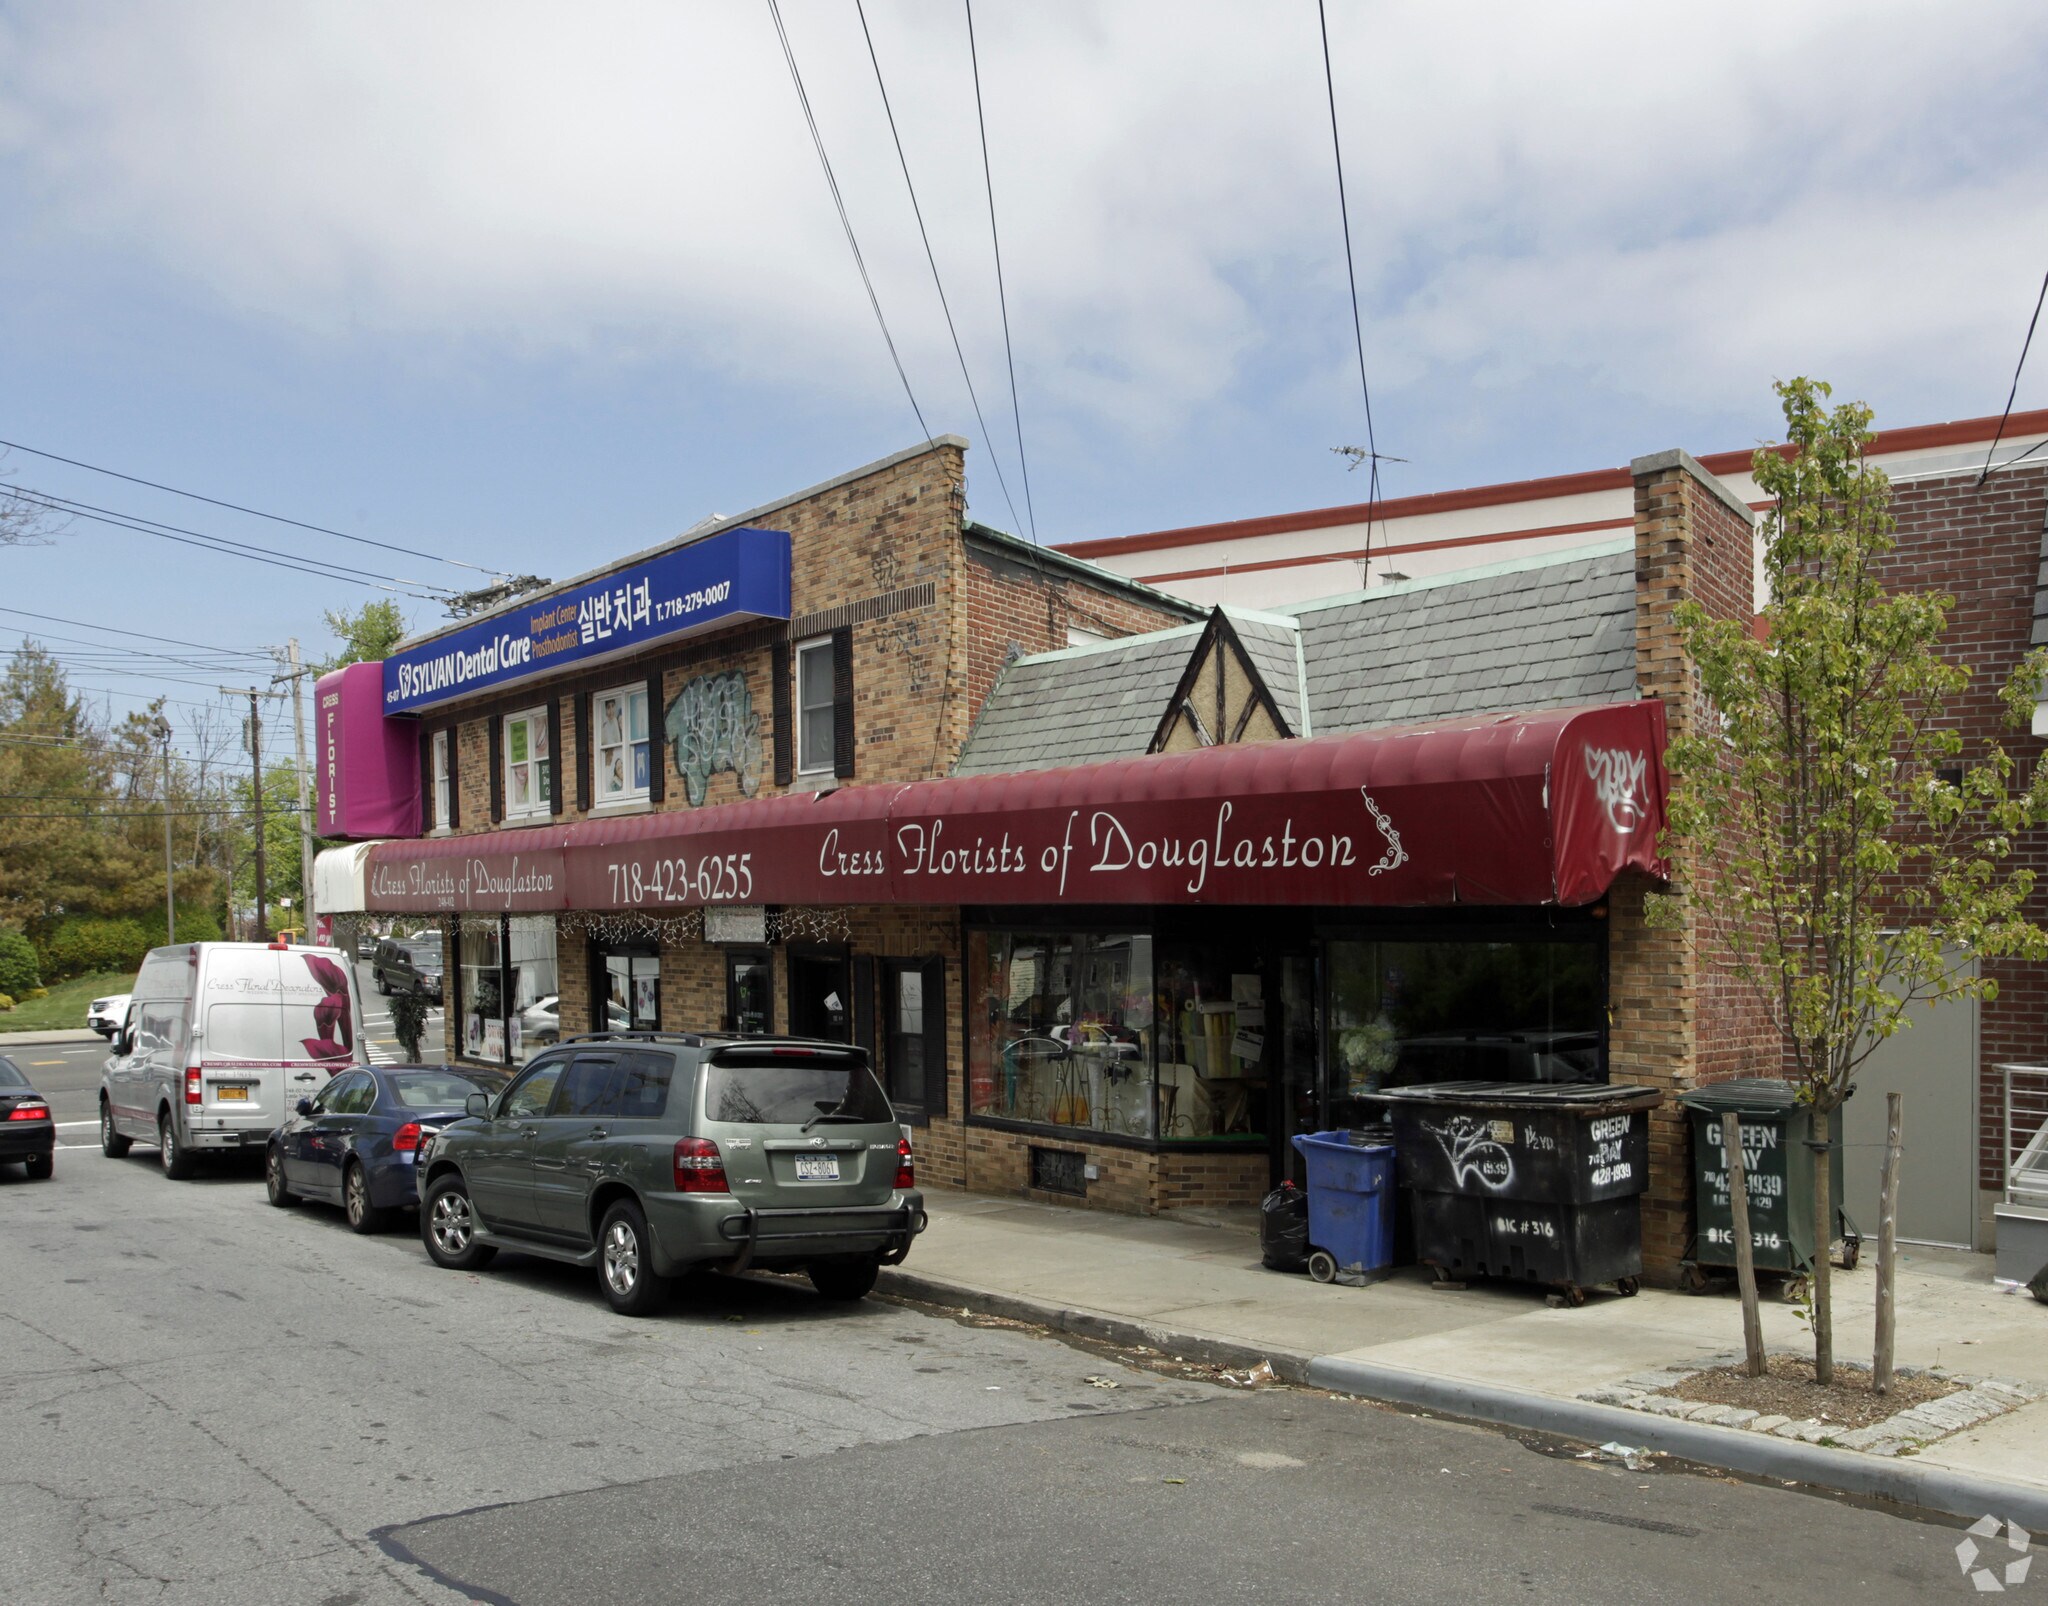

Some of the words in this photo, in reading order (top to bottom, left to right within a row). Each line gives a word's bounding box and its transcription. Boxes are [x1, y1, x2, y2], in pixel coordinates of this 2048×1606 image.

[530, 614, 556, 636] Implant
[556, 604, 577, 624] Center
[577, 577, 651, 644] 실반치과
[531, 629, 578, 659] Prosthodontist
[412, 652, 456, 697] SYLVAN
[456, 636, 499, 684] Dental
[500, 633, 531, 669] Care
[322, 692, 339, 709] CRESS
[327, 713, 336, 825] FLORIST
[819, 828, 885, 877] Cress
[897, 819, 1027, 875] Florists
[1040, 810, 1079, 896] of
[1090, 801, 1356, 893] Douglaston
[379, 865, 407, 896] Cress
[409, 862, 456, 896] Florists
[459, 858, 471, 908] of
[474, 856, 554, 909] Douglaston
[608, 853, 752, 904] 718-423-6255
[207, 978, 235, 990] Cress
[235, 978, 270, 993] Floral
[270, 978, 324, 993] Decorators
[1591, 1114, 1631, 1142] GREEN
[1706, 1123, 1777, 1149] GEEN
[1591, 1163, 1632, 1185] 428-1939
[1531, 1220, 1554, 1238] 316
